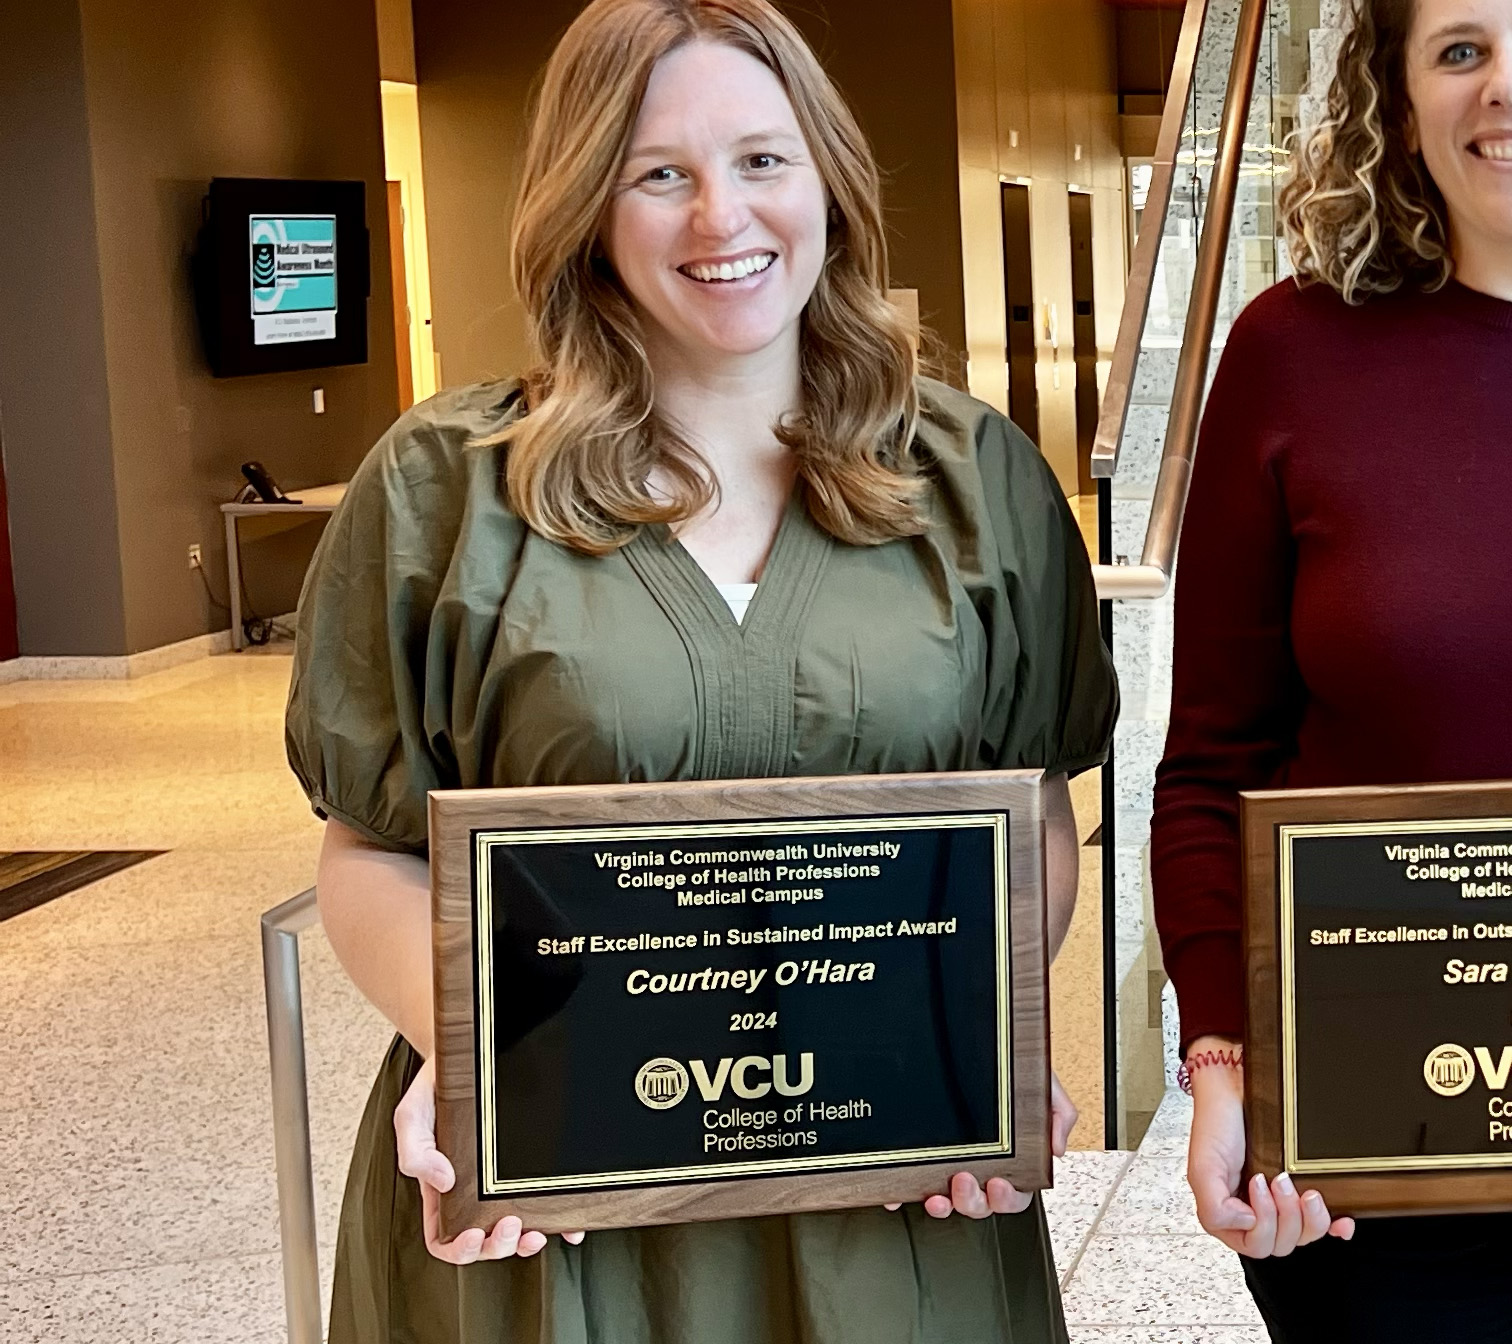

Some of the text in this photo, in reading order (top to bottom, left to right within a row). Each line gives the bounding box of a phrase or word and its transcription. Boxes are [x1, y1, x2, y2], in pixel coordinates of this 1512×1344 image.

[594, 841, 901, 871] Virginia Commonwealth University
[1384, 843, 1450, 864] Virginia
[617, 863, 881, 890] College of Health Professions
[1405, 863, 1470, 882] College
[1473, 861, 1492, 878] of
[677, 887, 824, 907] Medical Campus
[537, 917, 957, 955] Staff Excellence in Sustained Impact Award
[1309, 928, 1352, 945] Staff
[1355, 926, 1448, 944] Excellence
[1452, 924, 1469, 940] in
[626, 958, 876, 995] Courtney O'Hara
[1443, 959, 1509, 984] Sara
[729, 1011, 778, 1032] 2024
[688, 1052, 814, 1102] VCU
[703, 1098, 872, 1130] College of Health
[704, 1128, 818, 1153] Professions
